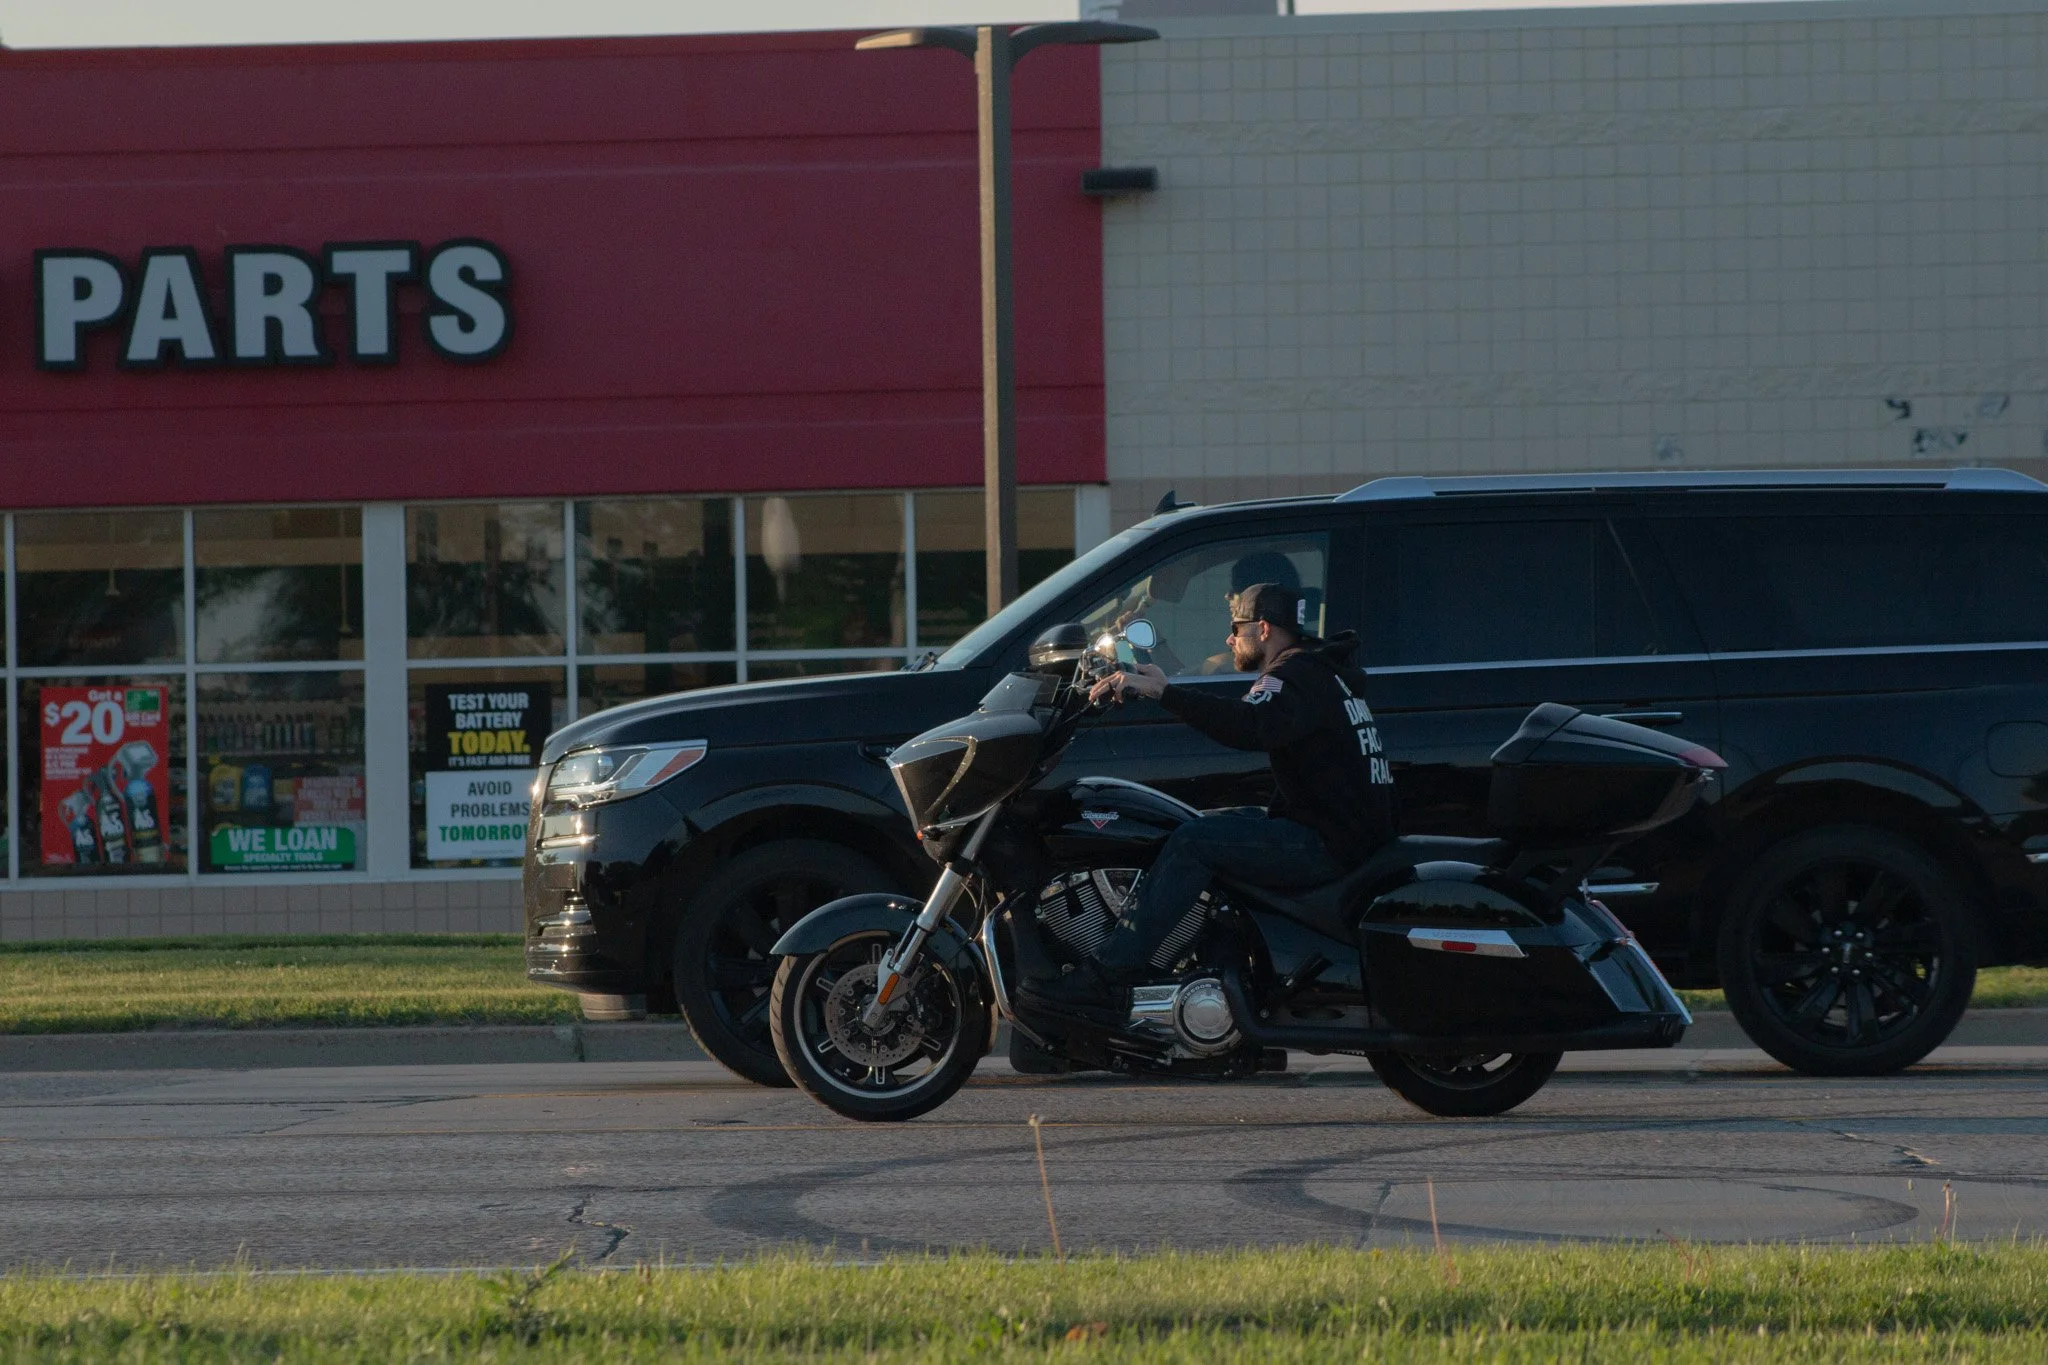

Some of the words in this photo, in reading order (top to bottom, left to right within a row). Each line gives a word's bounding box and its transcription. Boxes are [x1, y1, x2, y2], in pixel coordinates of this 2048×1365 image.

[41, 244, 506, 363] PARTS
[448, 693, 485, 710] TEST
[487, 692, 530, 709] YOUR
[43, 700, 125, 745] $20
[455, 711, 523, 729] BATTERY
[447, 730, 531, 755] TODAY.
[448, 756, 464, 767] IT'S
[466, 756, 487, 766] FAST
[468, 781, 512, 796] AVOID
[451, 802, 530, 818] PROBLEMS
[227, 827, 266, 852] WE
[275, 827, 338, 852] LOAN
[243, 852, 291, 863] SPECIALTY
[295, 852, 323, 862] TOOLS
